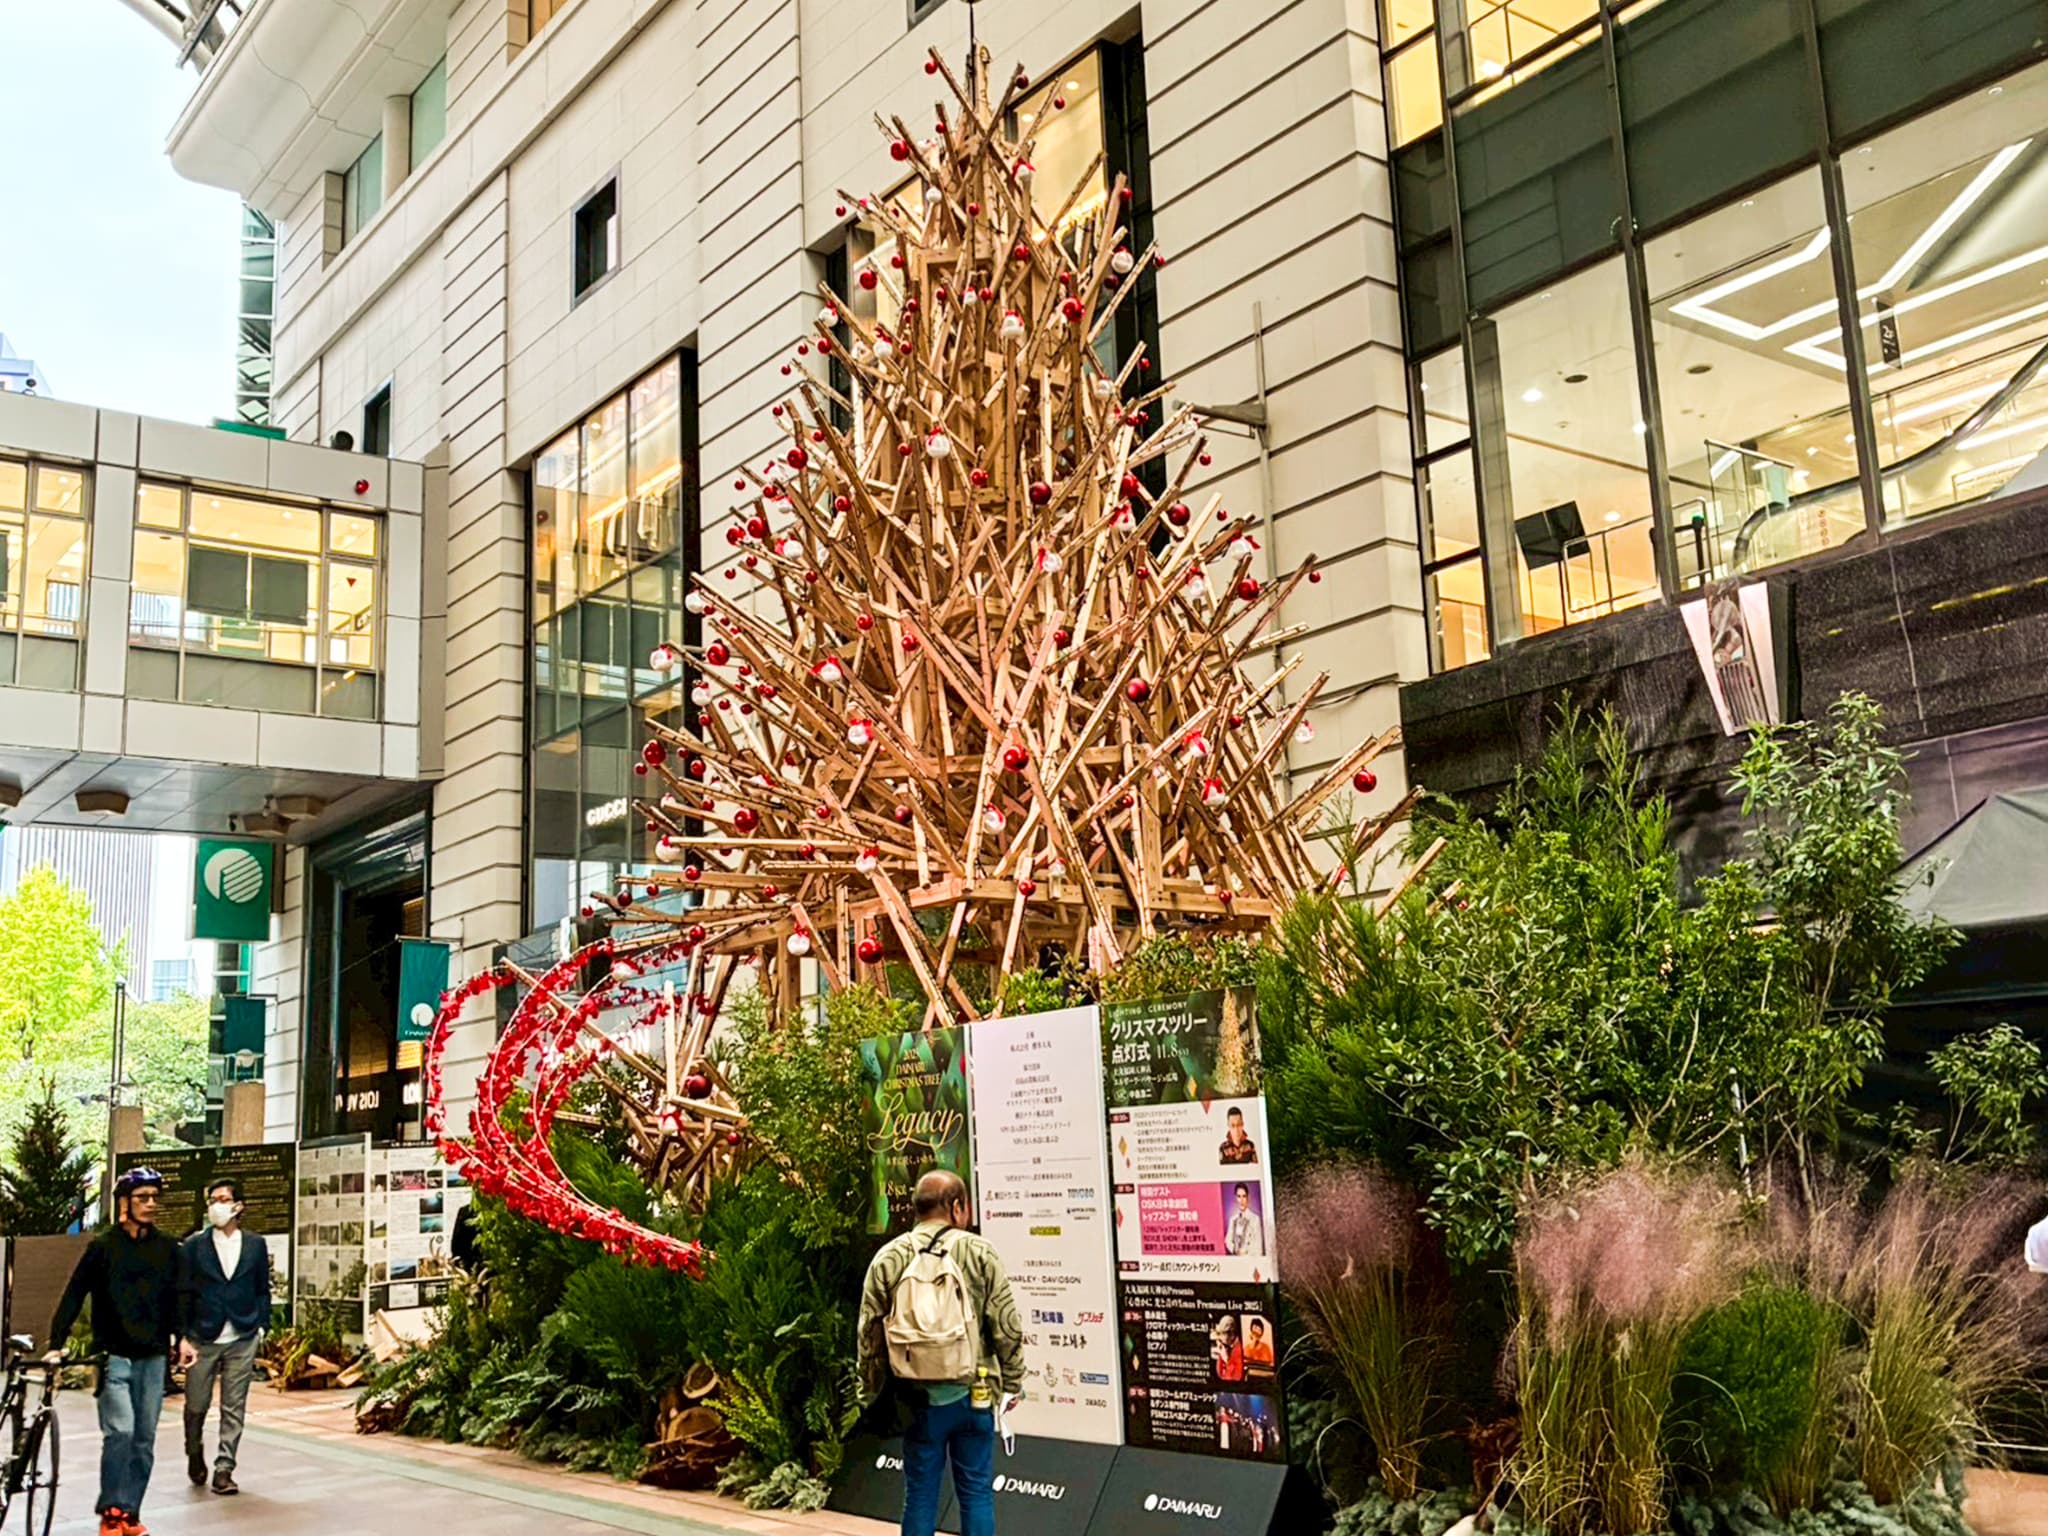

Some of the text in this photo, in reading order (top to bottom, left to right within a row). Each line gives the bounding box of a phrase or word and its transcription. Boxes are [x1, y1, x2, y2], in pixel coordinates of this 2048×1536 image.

[586, 797, 628, 826] GUCCI
[1148, 1001, 1187, 1013] CEREMONY
[1110, 1012, 1208, 1041] クリスマスツリー
[1112, 1041, 1151, 1064] 点灯式
[867, 1092, 963, 1153] Legacy
[1197, 1299, 1227, 1310] Premium
[1228, 1300, 1242, 1310] Live
[1004, 1478, 1065, 1500] DAIMARU
[1157, 1497, 1222, 1519] DAIMARU
